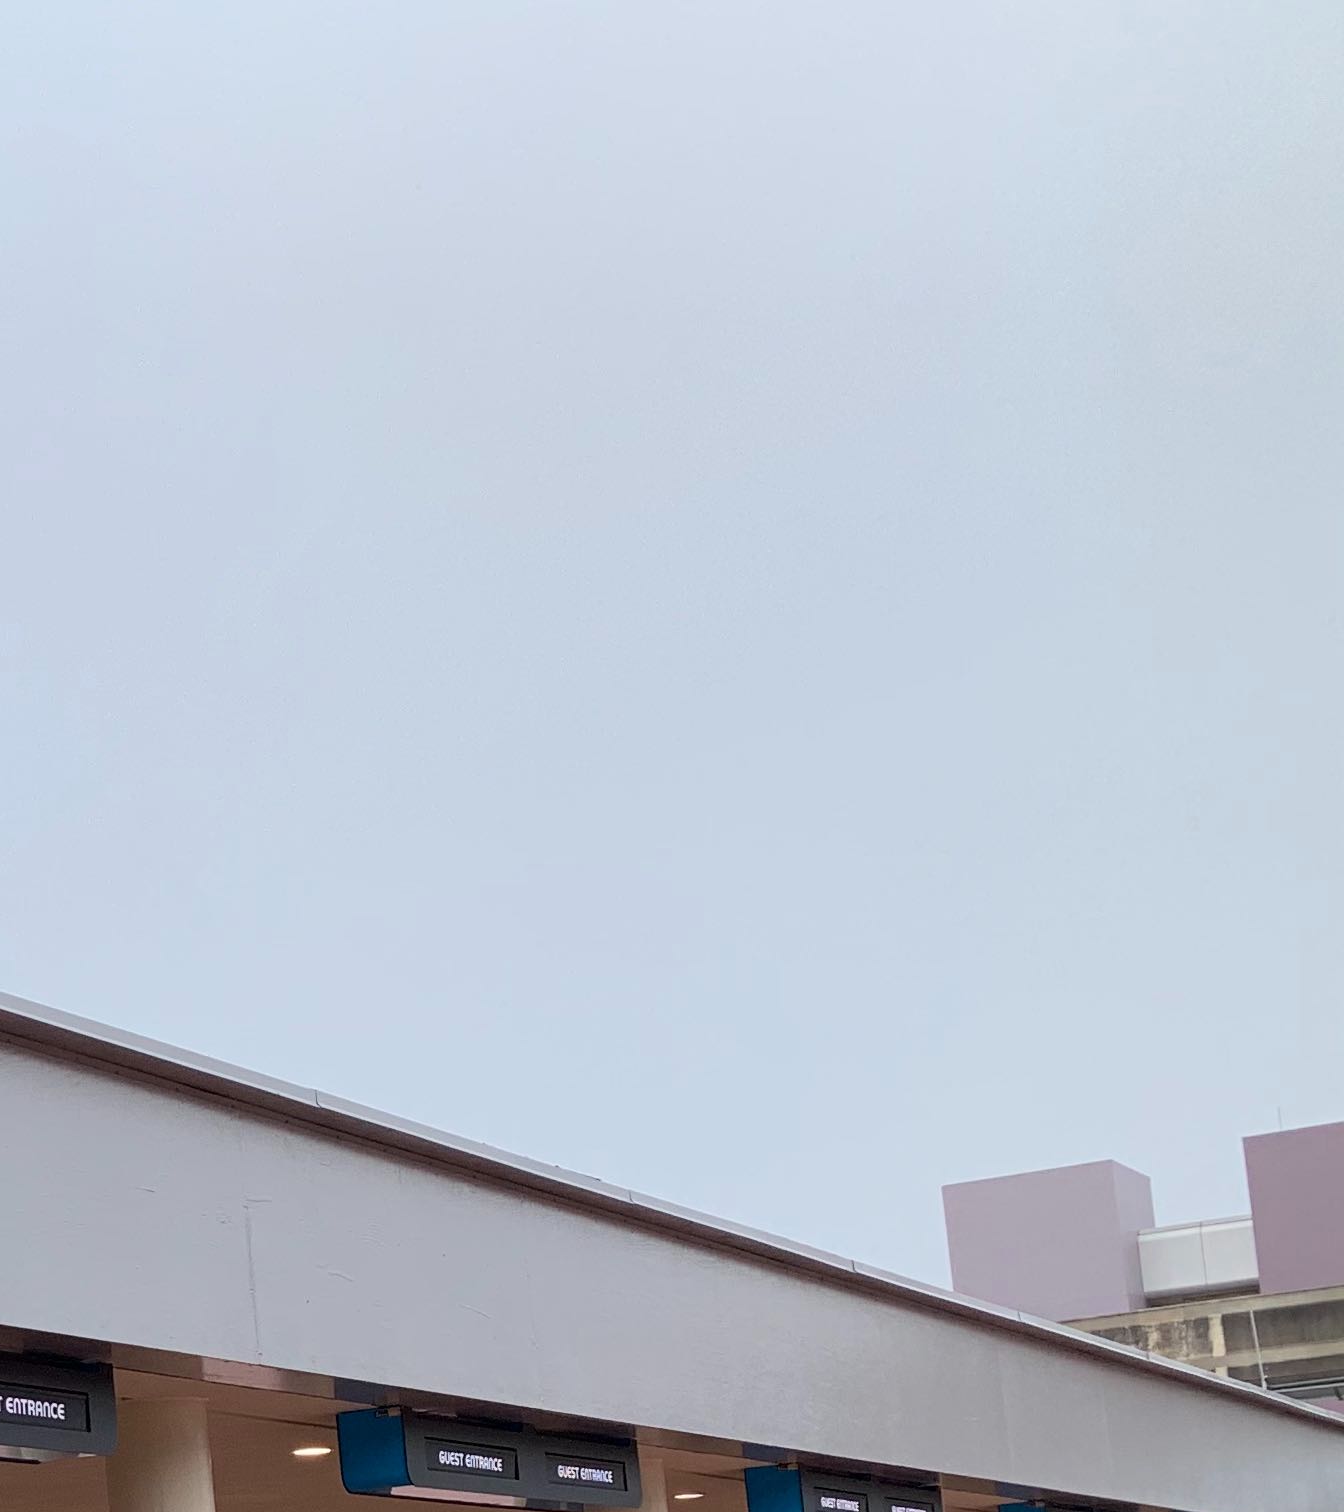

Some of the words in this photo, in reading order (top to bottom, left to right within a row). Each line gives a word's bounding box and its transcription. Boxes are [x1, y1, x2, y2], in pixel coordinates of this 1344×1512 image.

[5, 1396, 66, 1420] ENTRANCE
[439, 1450, 464, 1467] GUEST
[465, 1454, 503, 1472] ENTRANCE
[557, 1464, 579, 1480] GUEST
[580, 1467, 614, 1484] ENTRANCE
